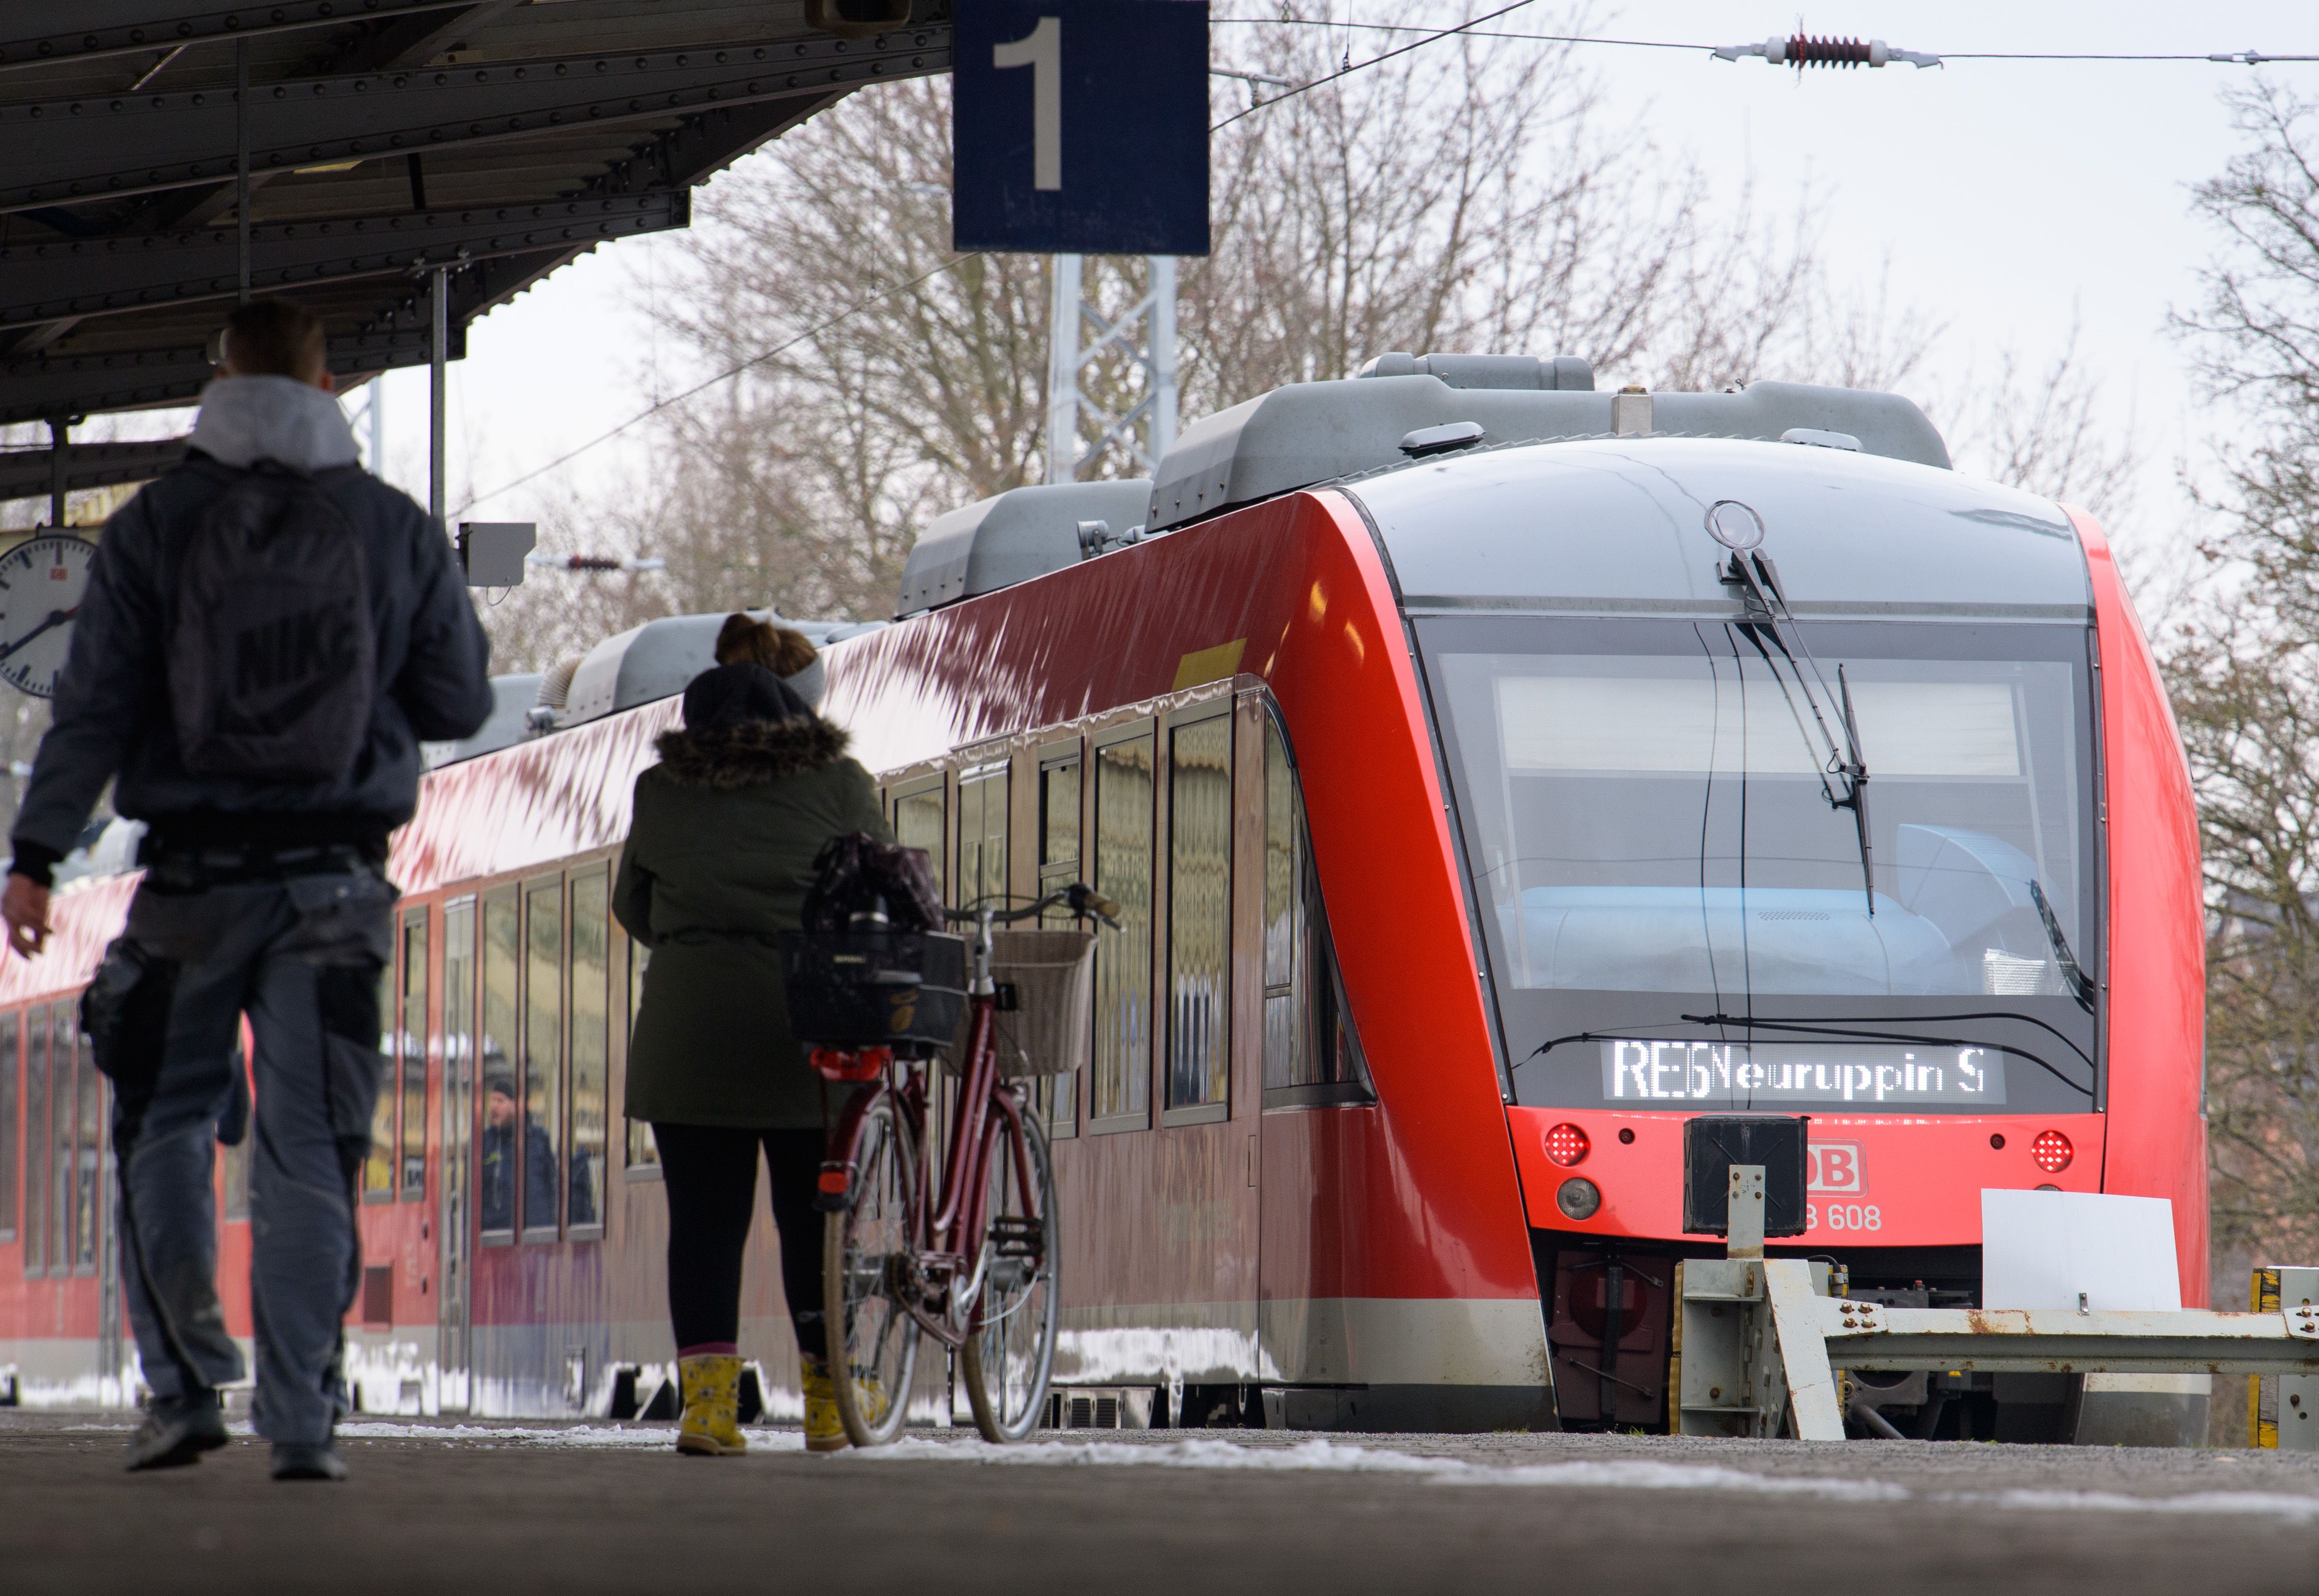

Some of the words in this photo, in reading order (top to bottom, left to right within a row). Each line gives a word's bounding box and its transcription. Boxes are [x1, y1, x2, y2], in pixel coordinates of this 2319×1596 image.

[993, 16, 1061, 191] 1
[1711, 1045, 1943, 1100] Neuruppin
[1958, 1048, 1984, 1092] S
[1827, 1204, 1882, 1231] 608
